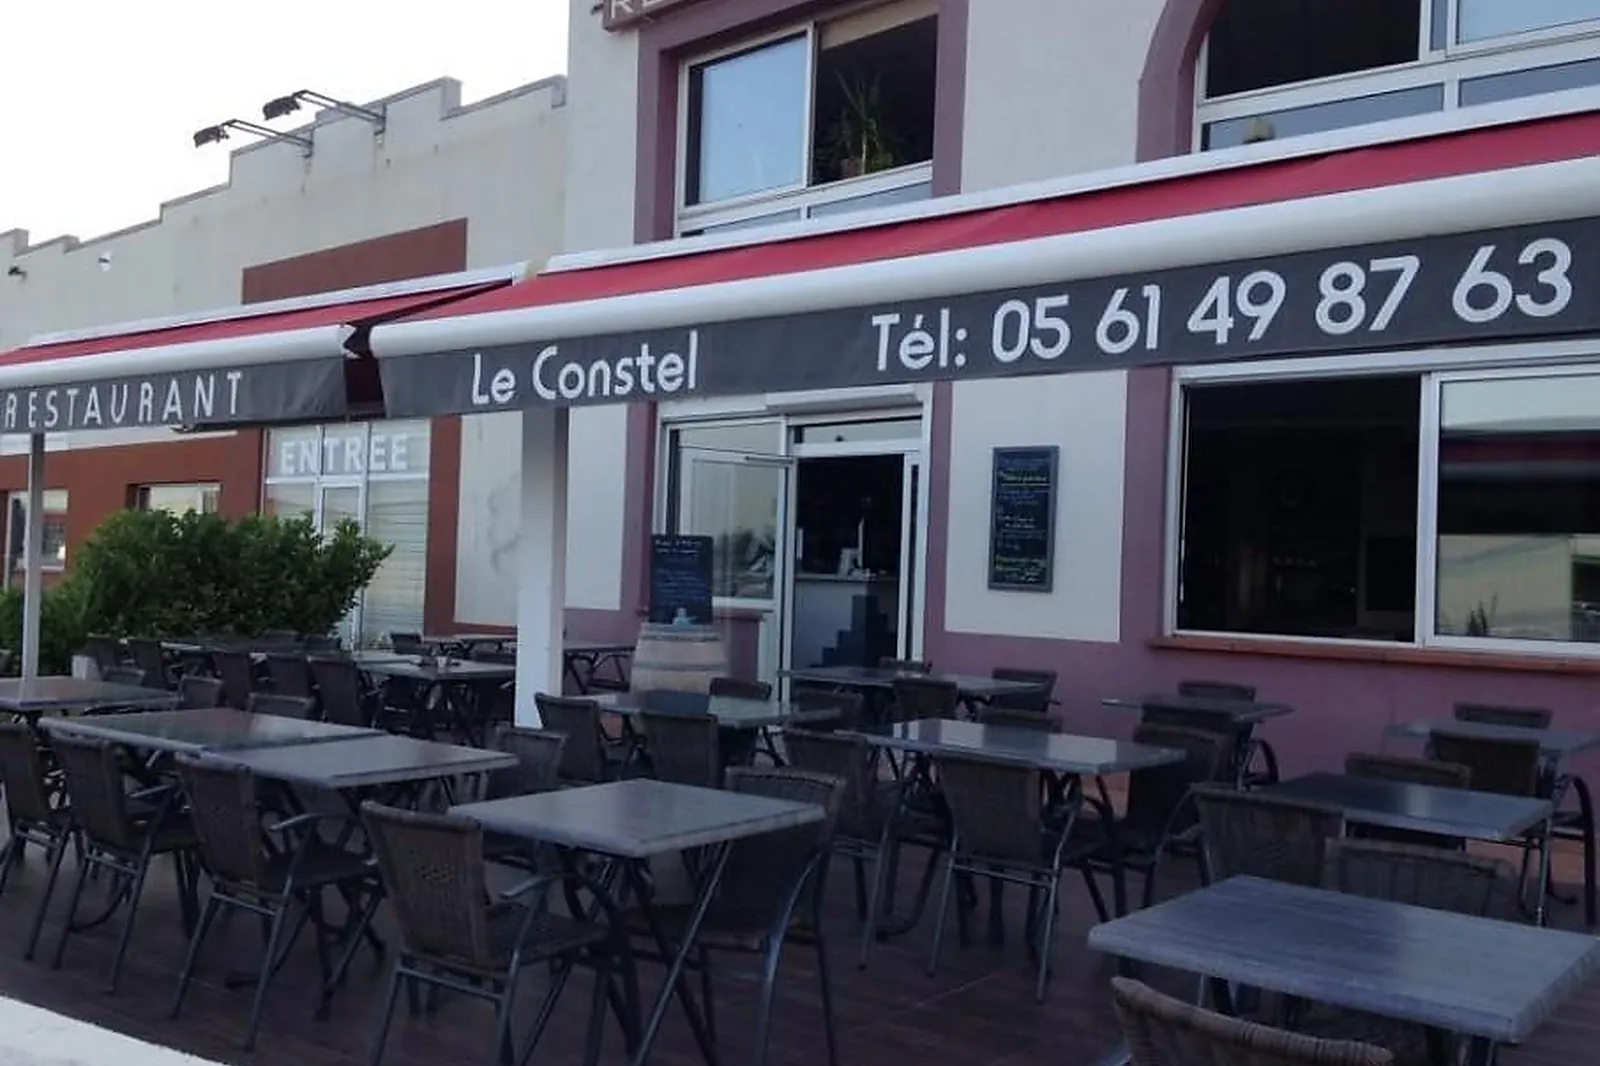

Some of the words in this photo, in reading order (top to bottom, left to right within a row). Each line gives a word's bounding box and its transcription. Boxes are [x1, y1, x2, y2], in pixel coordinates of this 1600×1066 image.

[872, 307, 967, 371] Tél:
[992, 294, 1071, 363] 05
[1096, 284, 1161, 354] 61
[1187, 270, 1287, 344] 49
[1315, 255, 1420, 335] 87
[1452, 238, 1572, 323] 63
[4, 371, 243, 429] RESTAURANT
[472, 353, 516, 405] Le
[532, 330, 698, 400] Constel
[280, 433, 408, 475] ENTREE
